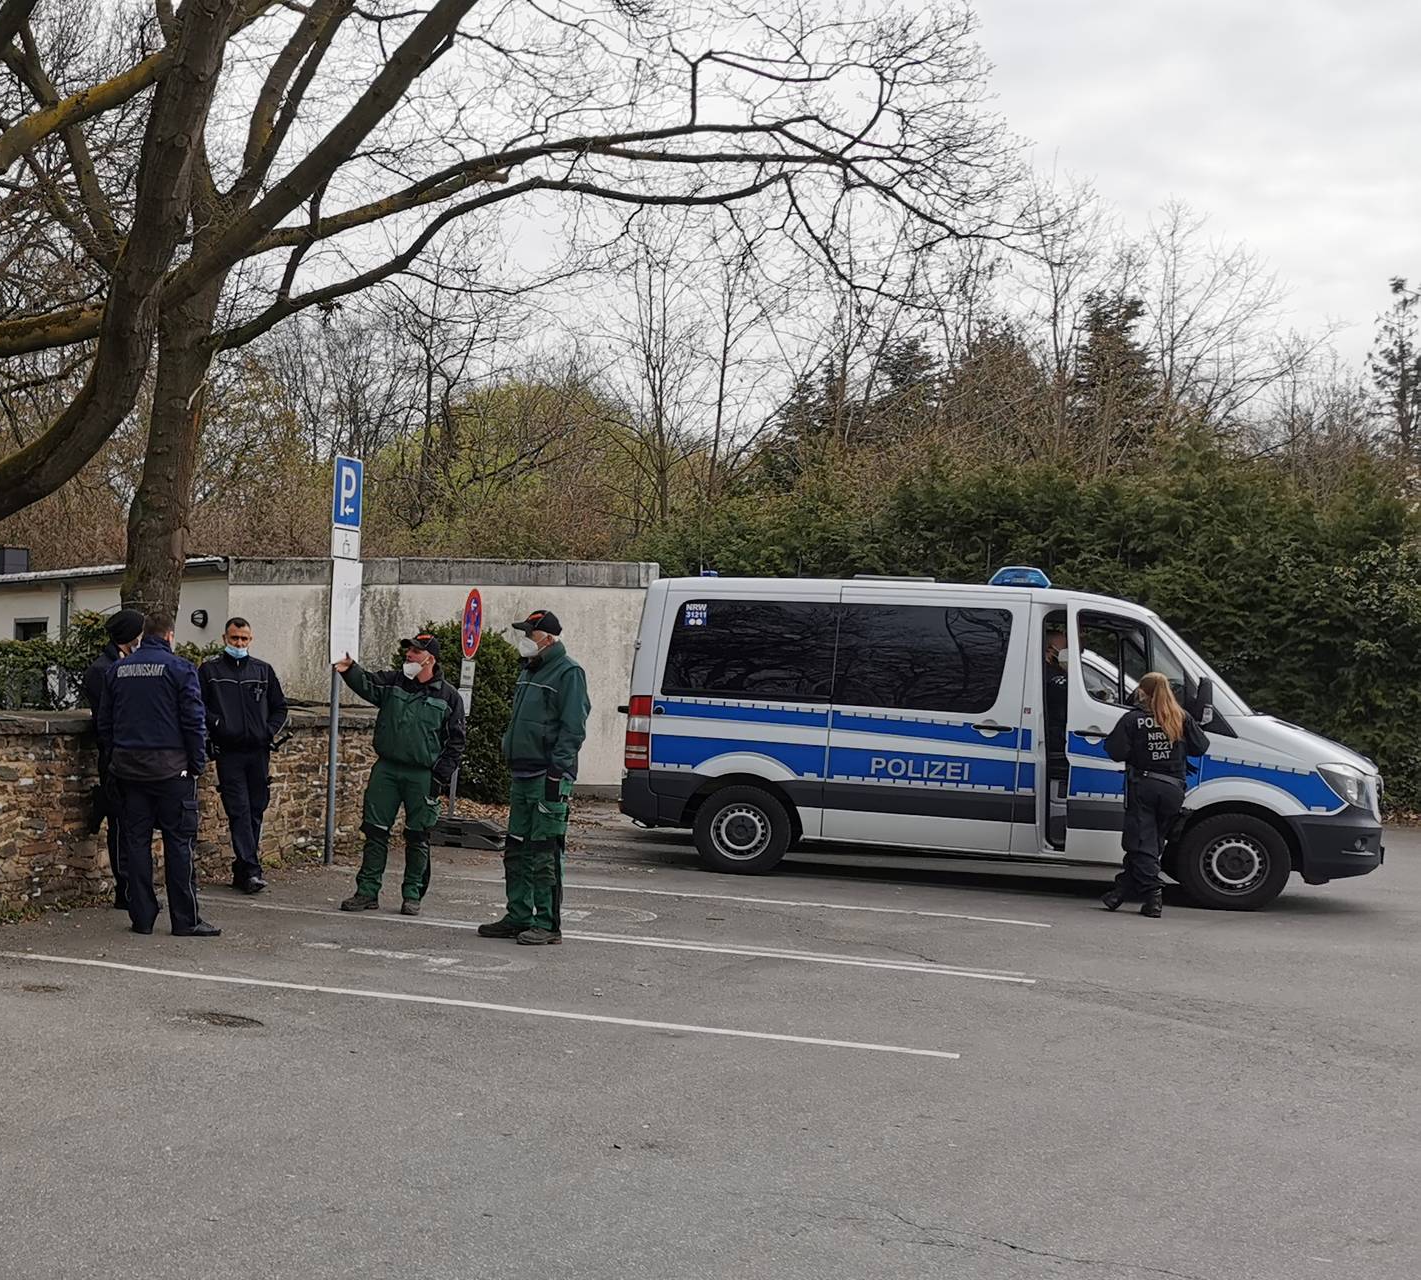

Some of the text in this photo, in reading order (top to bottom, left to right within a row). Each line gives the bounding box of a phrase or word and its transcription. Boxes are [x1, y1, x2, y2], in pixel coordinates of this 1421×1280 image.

[340, 466, 357, 517] P
[685, 603, 707, 611] NRW
[1152, 751, 1171, 760] BAT
[870, 757, 970, 781] POLIZEI
